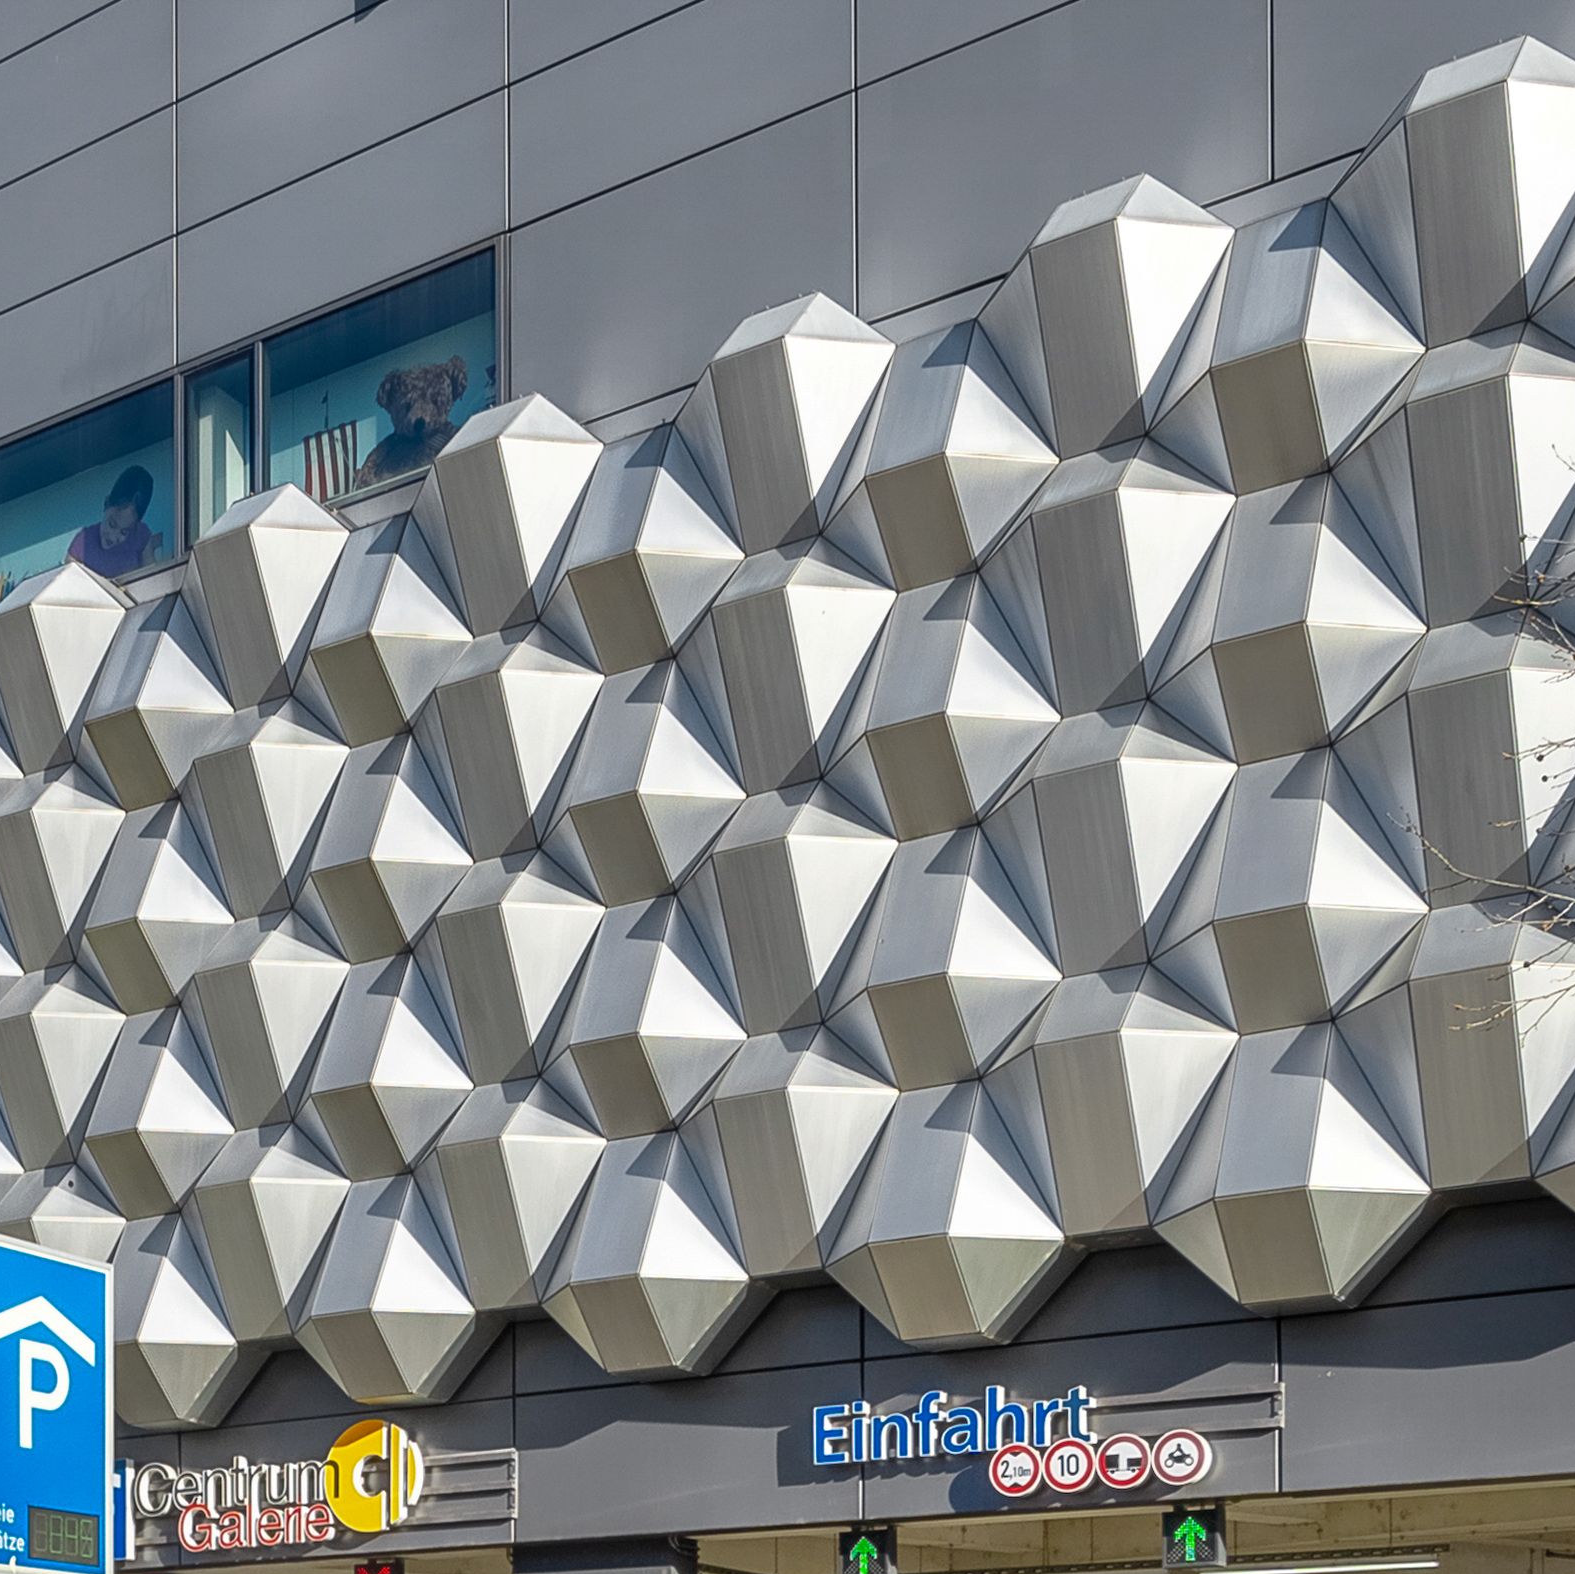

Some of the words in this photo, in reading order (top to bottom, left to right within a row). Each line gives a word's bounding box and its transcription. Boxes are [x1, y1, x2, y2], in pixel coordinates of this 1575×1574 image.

[19, 1338, 70, 1449] P
[813, 1384, 1097, 1465] Einfahrt
[134, 1456, 341, 1517] Centrum
[1001, 1460, 1031, 1479] 2,10m
[1058, 1454, 1079, 1477] 10
[178, 1502, 336, 1552] Galerie
